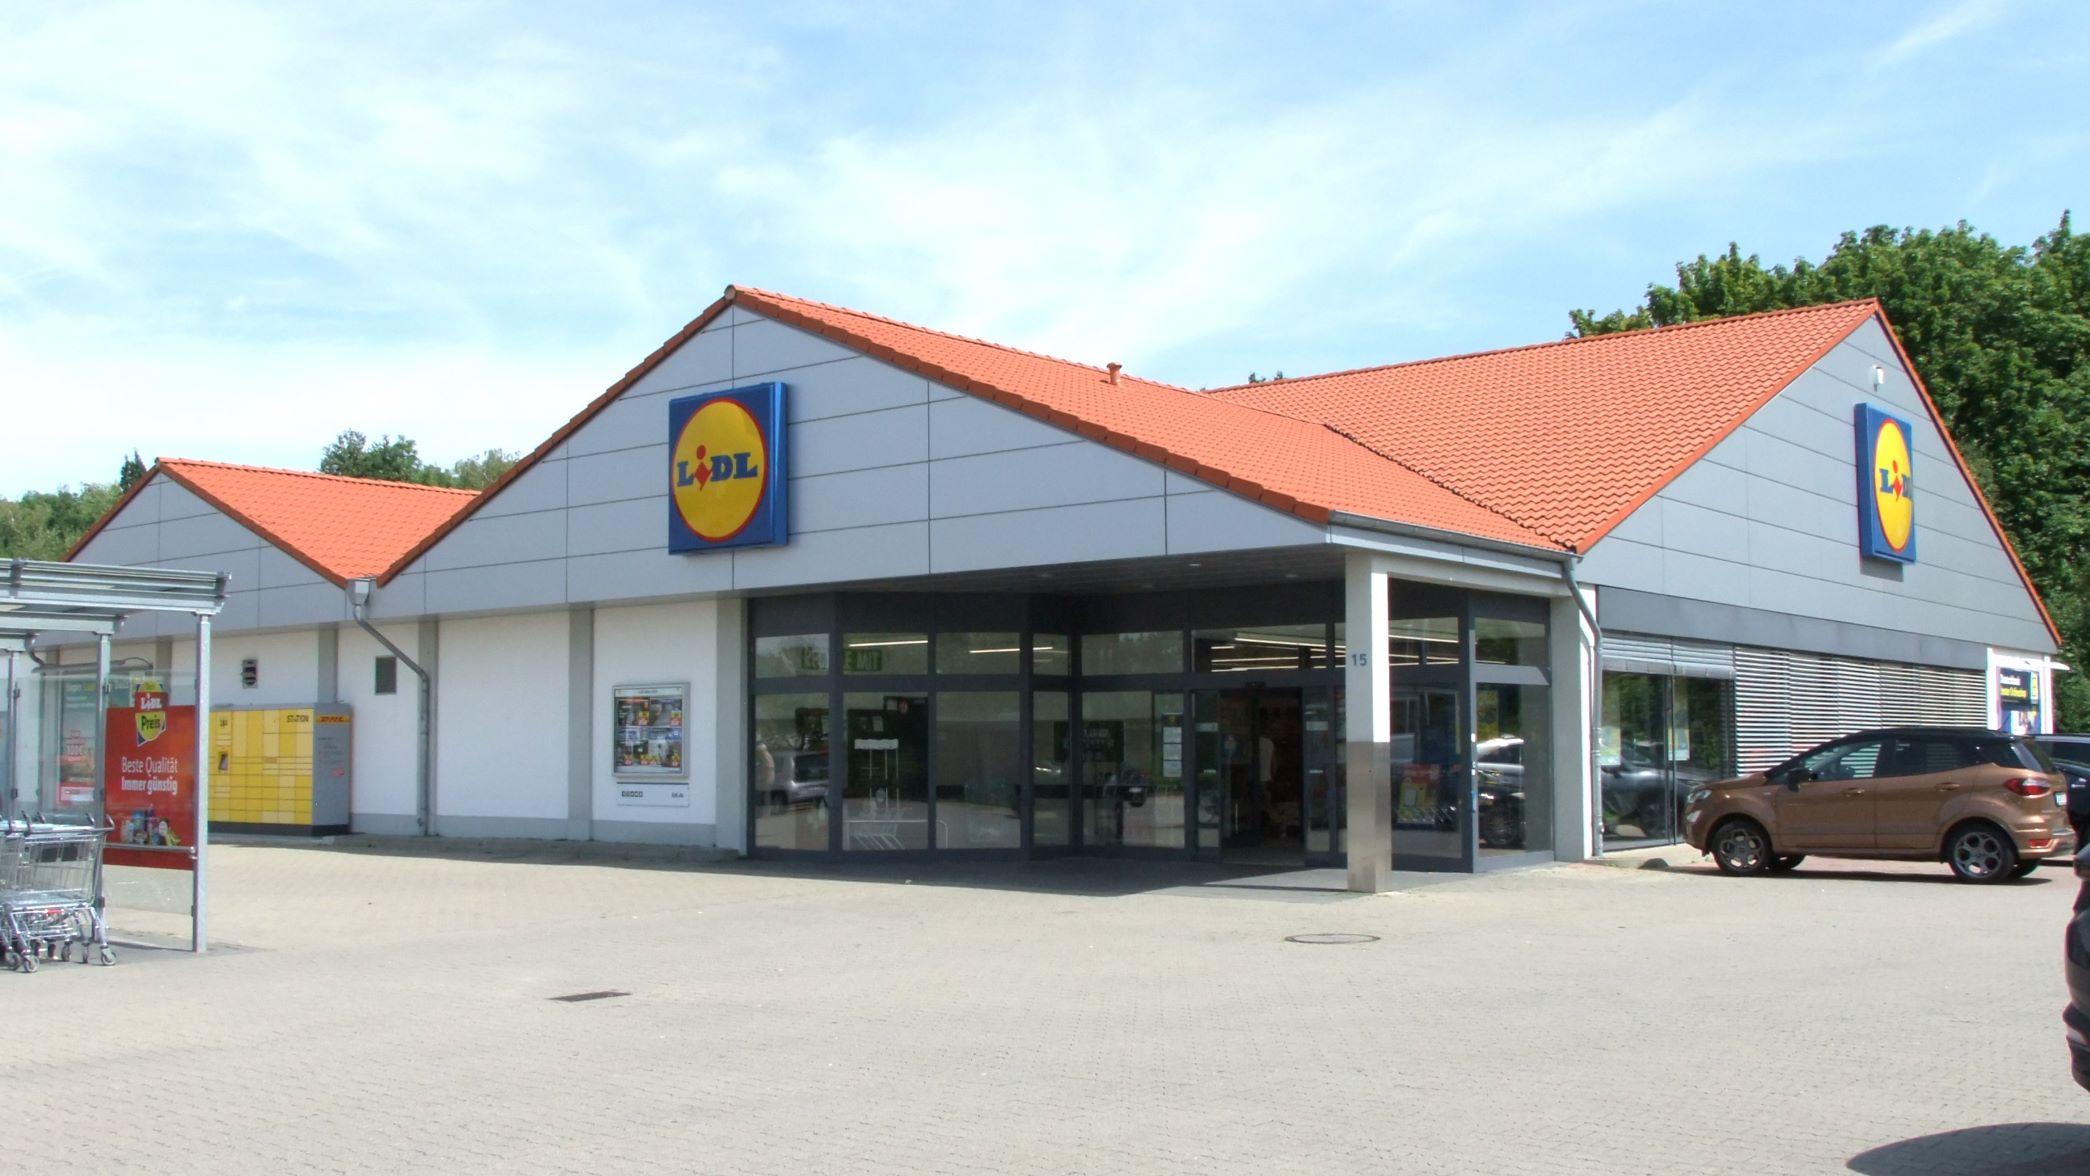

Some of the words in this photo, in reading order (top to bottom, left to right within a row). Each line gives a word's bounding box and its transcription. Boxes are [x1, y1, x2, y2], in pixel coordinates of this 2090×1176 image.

[677, 445, 758, 491] LIDL
[1351, 653, 1367, 666] 15
[141, 715, 161, 731] Preis
[121, 756, 144, 773] Beste
[145, 756, 178, 777] Qualität
[121, 776, 146, 791] Immer
[147, 775, 178, 796] günstig
